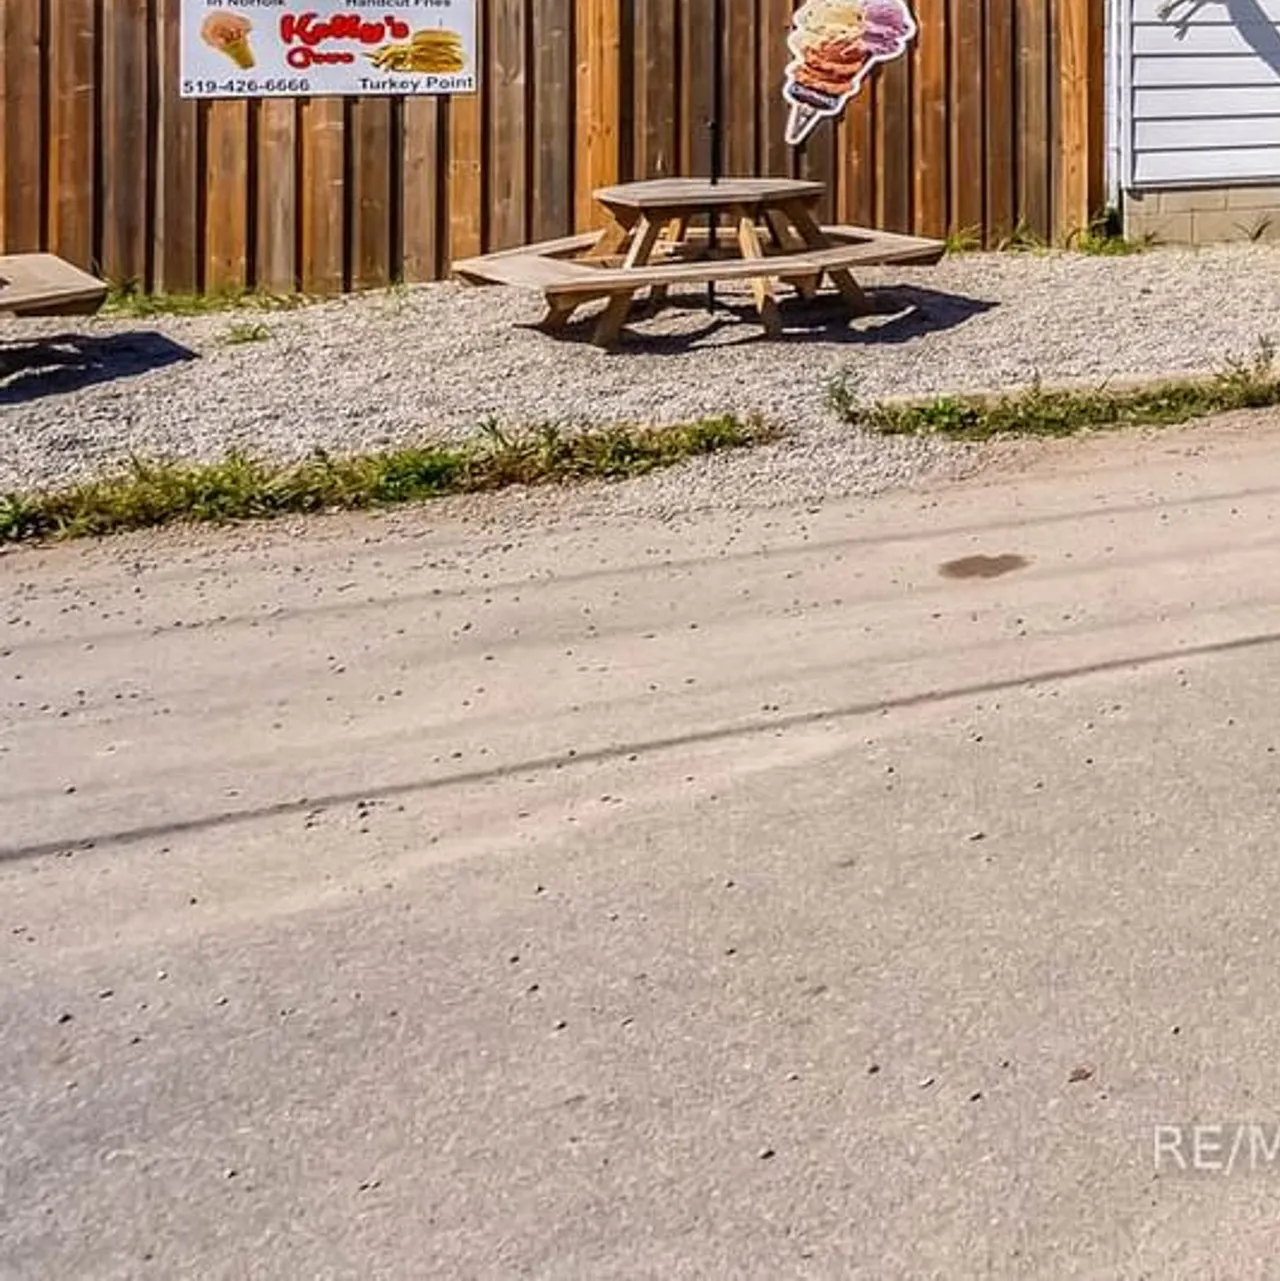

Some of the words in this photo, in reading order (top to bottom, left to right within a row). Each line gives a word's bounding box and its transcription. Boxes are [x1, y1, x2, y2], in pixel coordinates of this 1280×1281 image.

[184, 80, 310, 93] 519-426-6666
[358, 78, 419, 91] Turkey
[427, 76, 473, 89] Point
